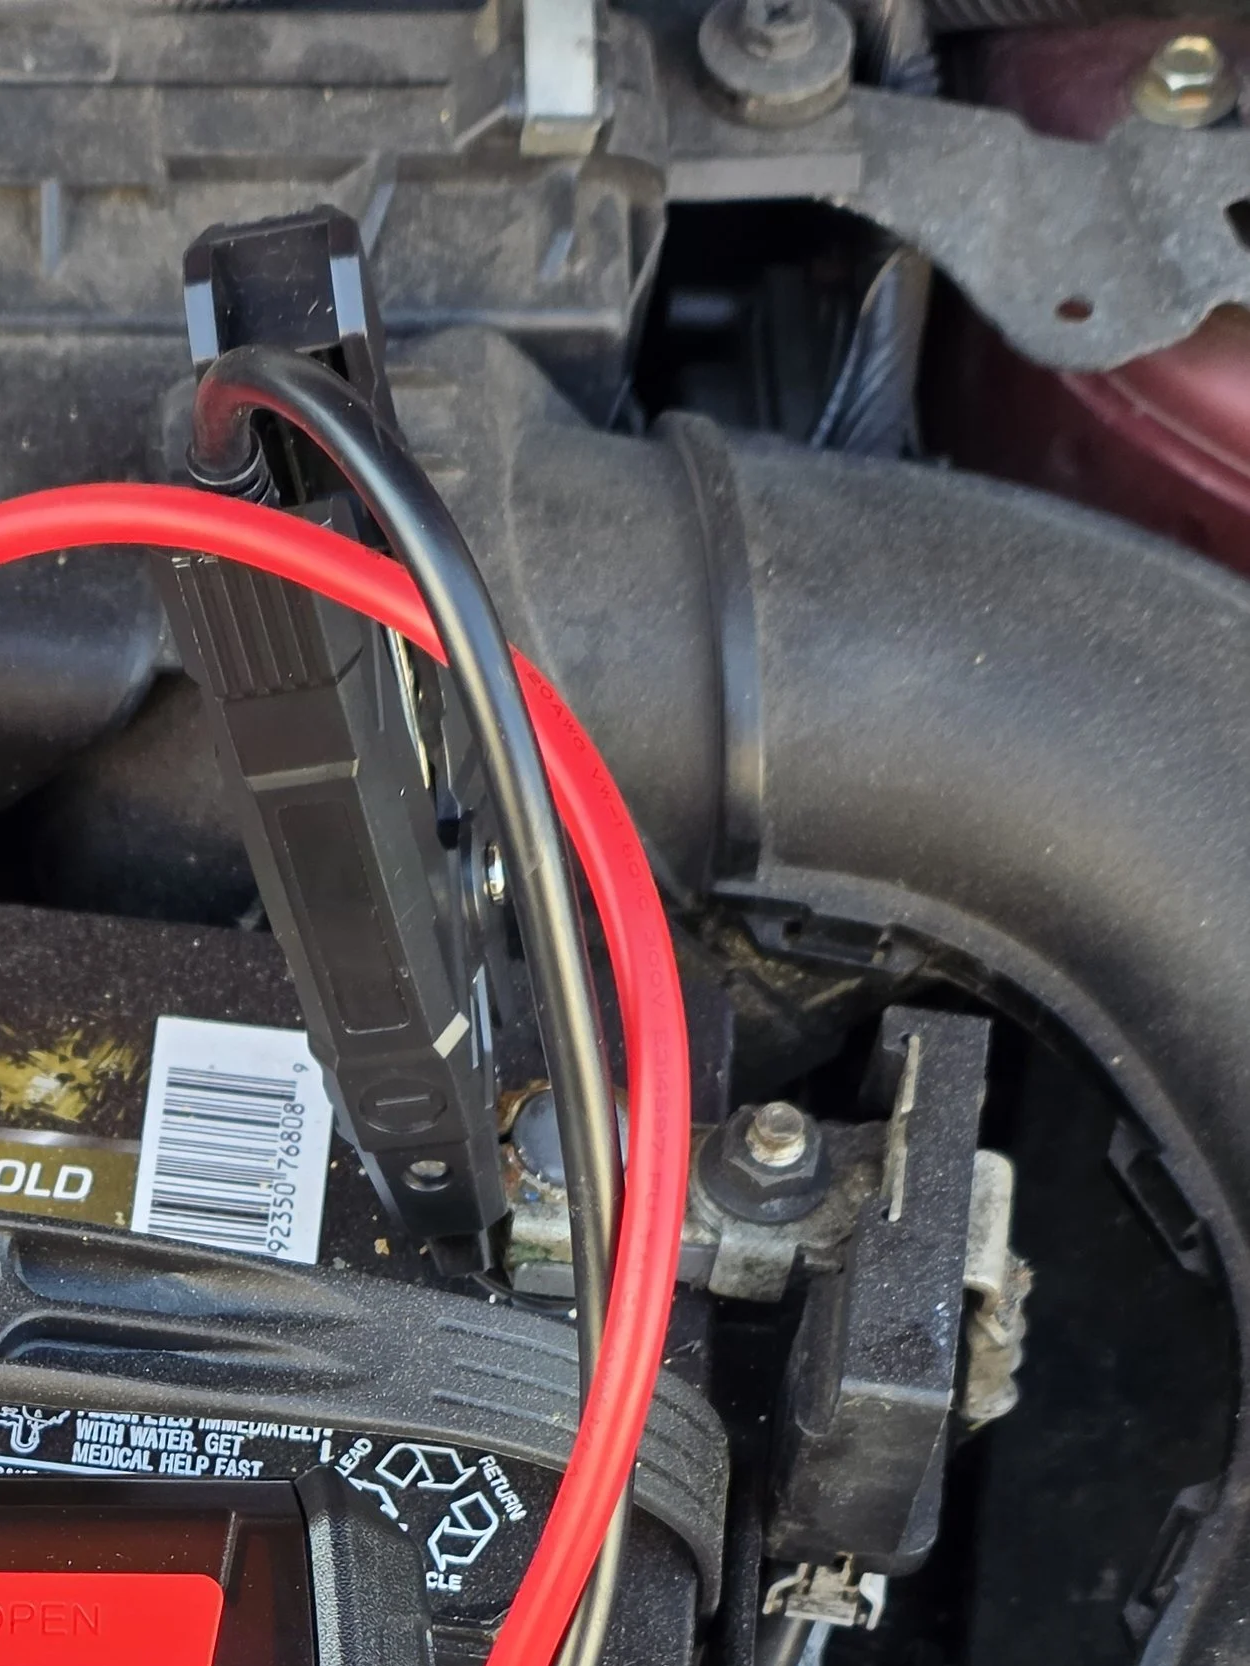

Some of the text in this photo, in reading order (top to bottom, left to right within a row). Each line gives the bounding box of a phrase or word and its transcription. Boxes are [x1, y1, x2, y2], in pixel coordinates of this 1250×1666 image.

[277, 1102, 306, 1171] 76808
[267, 1182, 297, 1253] 92350
[72, 1442, 265, 1479] MEDICAL HELP FAST
[75, 1418, 124, 1445] WITH
[128, 1426, 198, 1453] WATER.
[204, 1435, 245, 1457] GET
[334, 1437, 373, 1478] LEAD
[478, 1455, 528, 1522] RETURN
